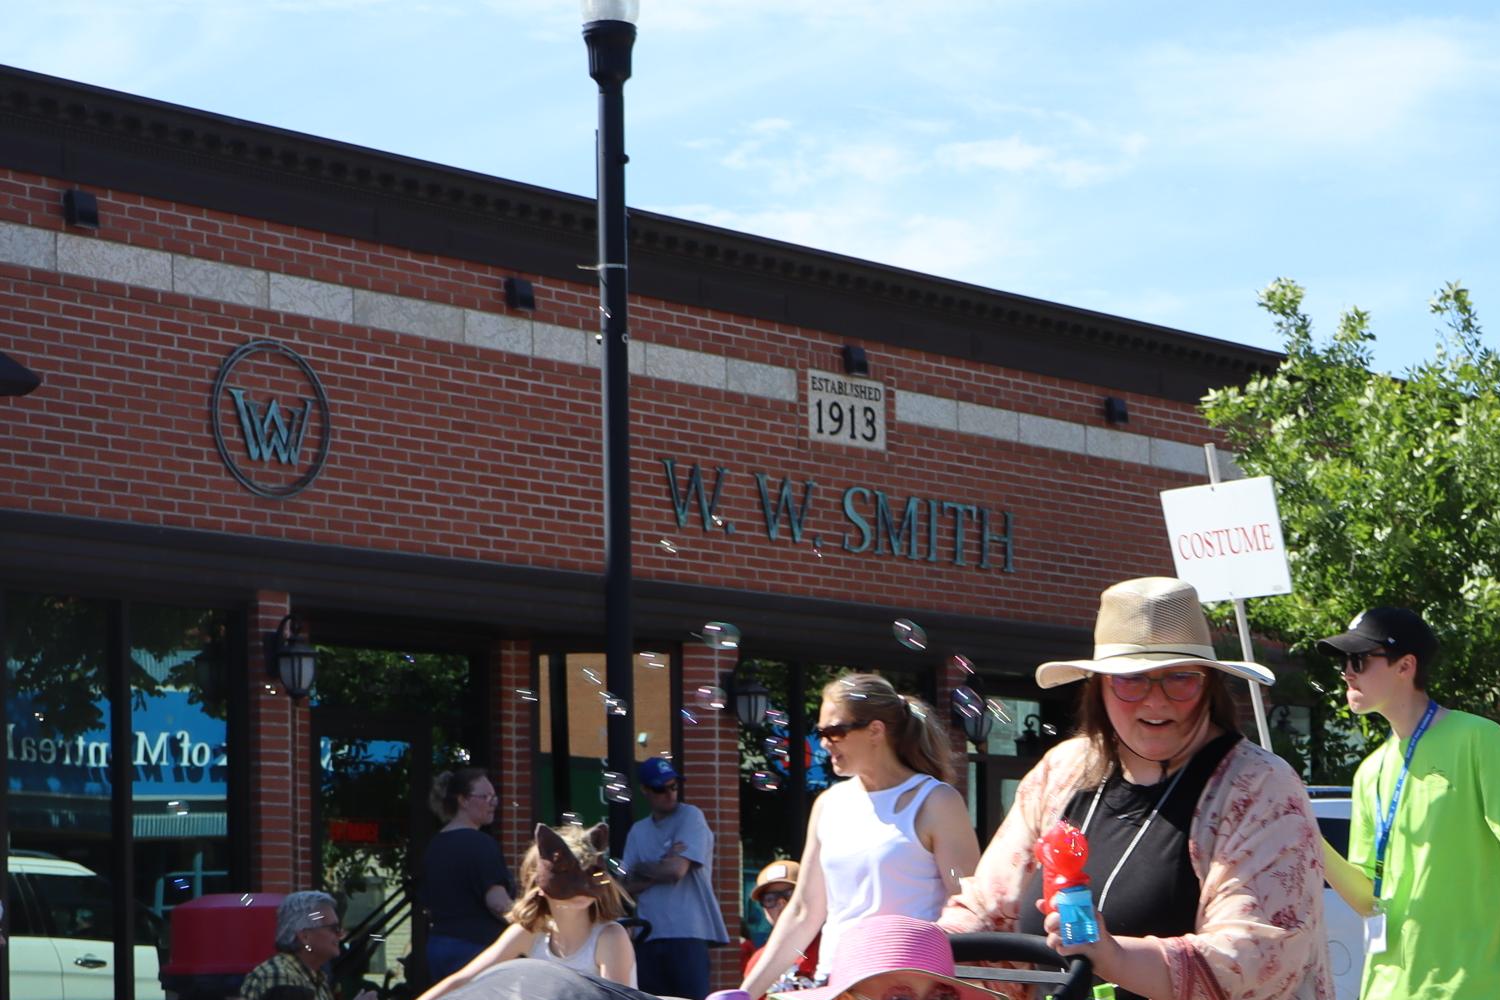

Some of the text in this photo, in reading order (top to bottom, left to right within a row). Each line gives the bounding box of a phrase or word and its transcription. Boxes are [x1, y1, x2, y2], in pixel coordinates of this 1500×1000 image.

[811, 376, 882, 402] ESTABLISHED
[816, 399, 877, 443] 1913
[661, 458, 1016, 574] W. W. SMITH
[1178, 523, 1275, 561] COSTUME
